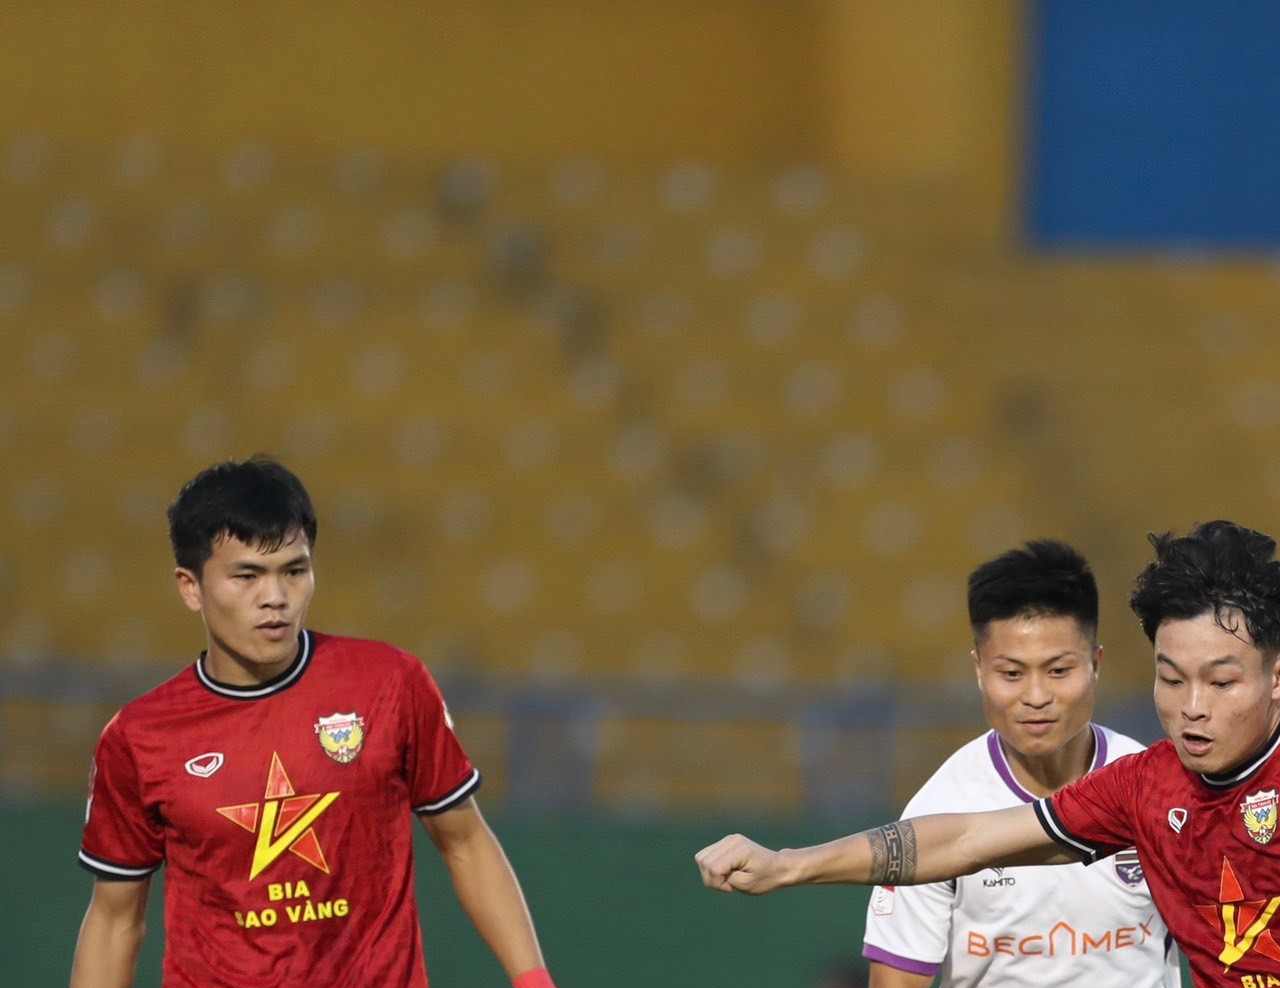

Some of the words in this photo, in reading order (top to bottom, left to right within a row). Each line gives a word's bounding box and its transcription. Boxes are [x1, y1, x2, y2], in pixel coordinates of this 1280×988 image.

[268, 880, 310, 901] BIA
[983, 877, 1016, 888] KAMITO
[286, 898, 349, 923] VÀNG
[967, 914, 1154, 958] BECAMEX
